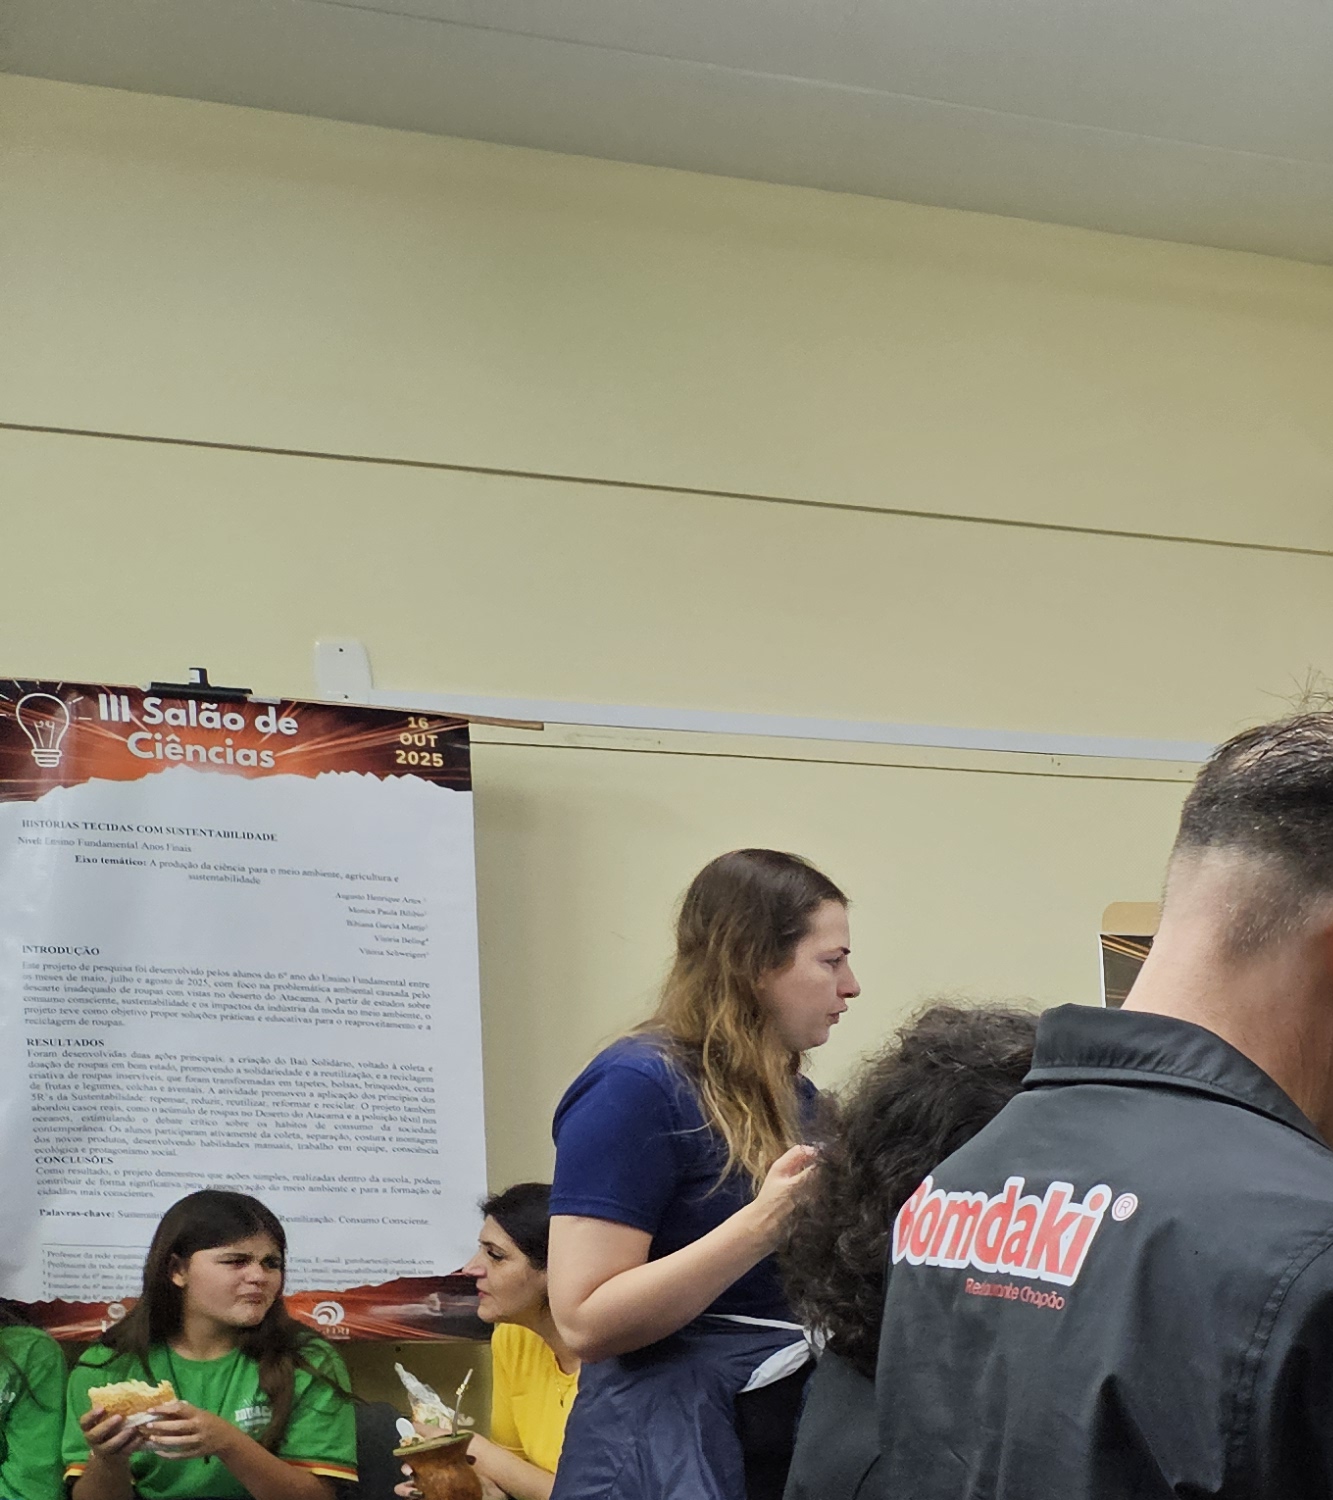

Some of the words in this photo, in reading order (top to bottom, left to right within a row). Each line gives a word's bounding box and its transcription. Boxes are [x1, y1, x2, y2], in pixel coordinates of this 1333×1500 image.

[99, 694, 130, 722] III
[143, 696, 242, 730] Salão
[255, 702, 298, 735] de
[407, 715, 428, 729] 16
[399, 733, 438, 749] OUT
[127, 732, 275, 768] Ciências
[396, 750, 443, 767] 2025
[22, 818, 80, 830] HISTÓRIAS
[81, 821, 134, 832] TECIDAS
[136, 824, 163, 835] COM
[165, 827, 278, 841] SUSTENTABILIDADE
[77, 838, 139, 849] Fundamental
[141, 842, 164, 851] Anos
[75, 855, 98, 864] Eixo
[101, 856, 147, 867] temático:
[149, 859, 157, 867] A
[159, 859, 199, 870] produção
[200, 861, 212, 870] da
[213, 863, 246, 872] ciência
[248, 867, 269, 875] para
[278, 868, 301, 876] meio
[302, 869, 343, 880] ambiente,
[345, 873, 392, 883] agricultura
[188, 873, 261, 885] sustentabilidade
[22, 944, 100, 956] INTRODUÇÃO
[43, 962, 77, 973] projeto
[78, 962, 91, 971] de
[92, 964, 133, 974] pesquisa
[26, 1037, 105, 1047] RESULTADOS
[35, 1154, 114, 1165] CONCLUSÕES
[39, 1208, 116, 1219] Palavras-chave:
